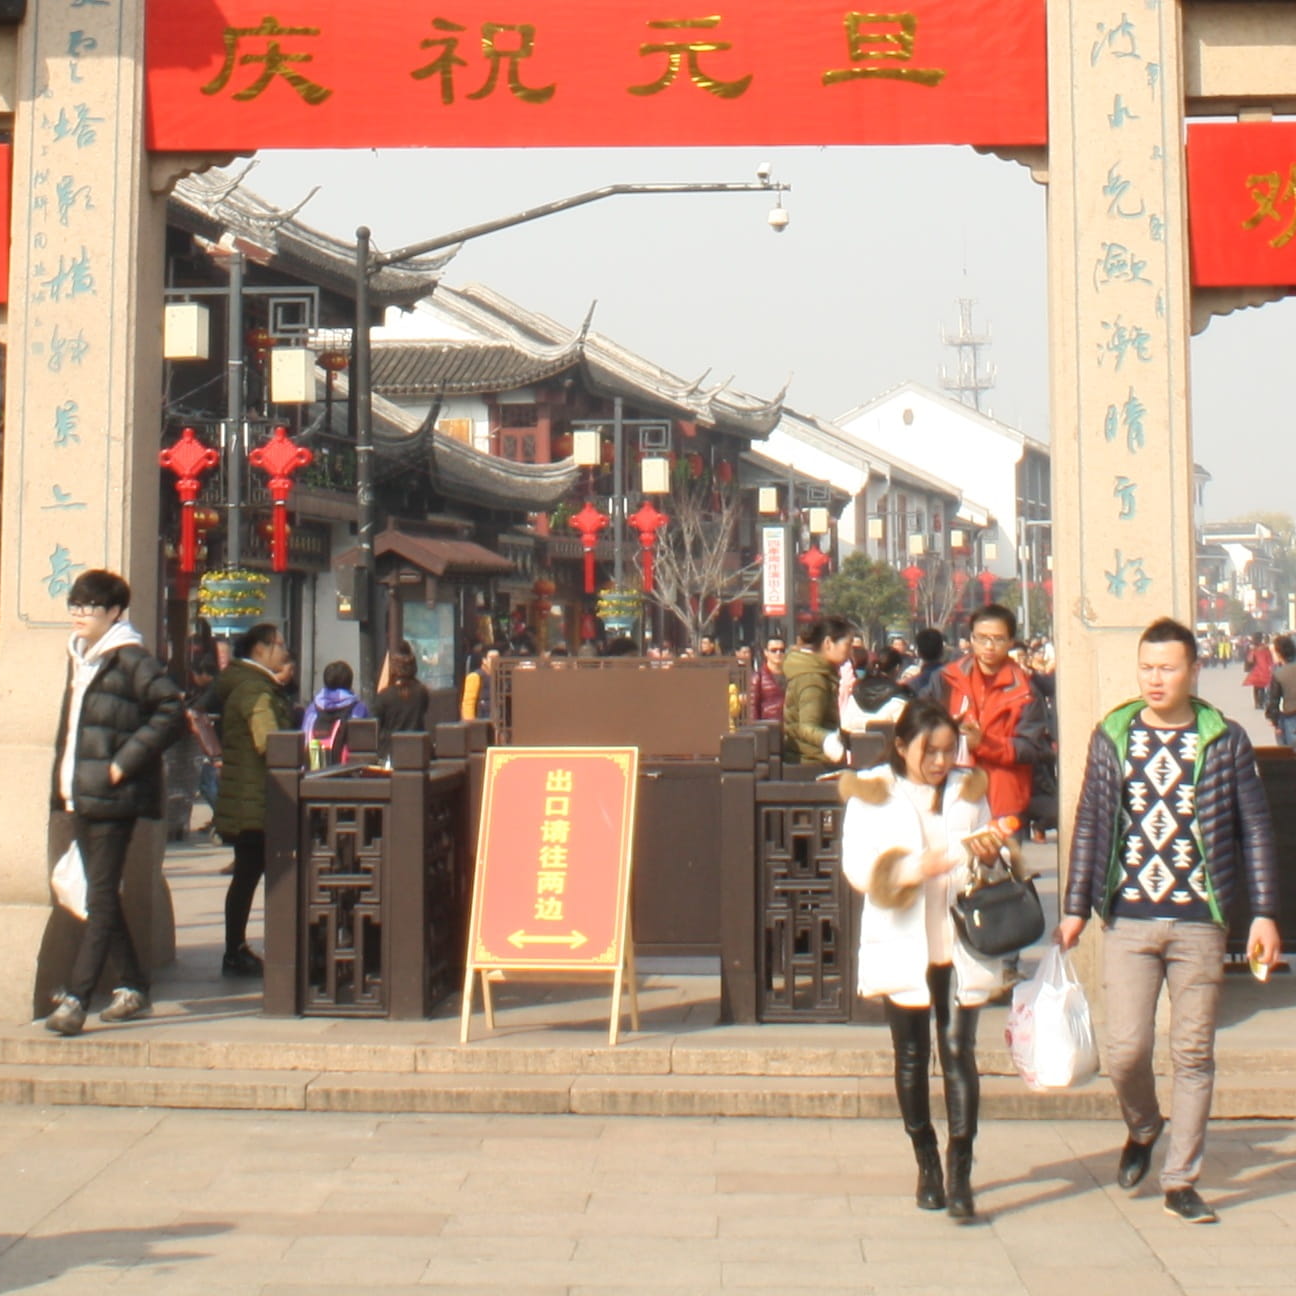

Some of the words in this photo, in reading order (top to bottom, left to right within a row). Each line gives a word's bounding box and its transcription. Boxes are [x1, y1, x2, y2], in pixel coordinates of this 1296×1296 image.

[199, 10, 947, 105] 庆祝元旦
[534, 769, 573, 921] 出口请往两边
